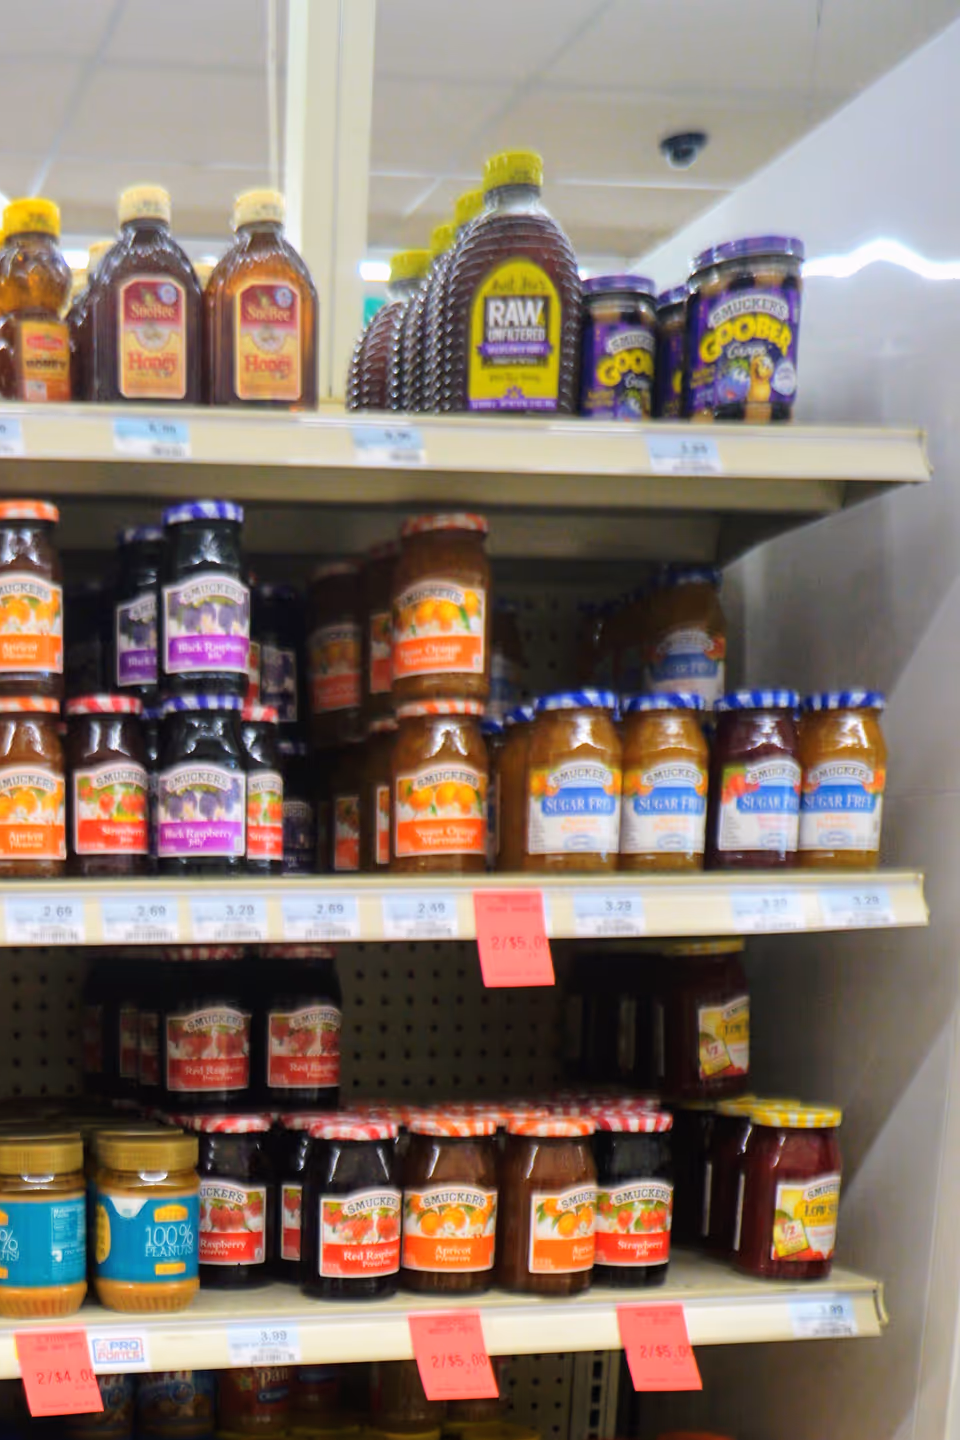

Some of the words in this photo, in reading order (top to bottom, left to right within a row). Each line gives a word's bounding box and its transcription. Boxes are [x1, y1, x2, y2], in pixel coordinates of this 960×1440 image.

[488, 302, 541, 328] RAW
[486, 328, 546, 342] UNFILTERED
[698, 313, 794, 364] GOOBER
[25, 359, 68, 371] HONEY
[128, 350, 178, 373] Honey
[244, 354, 294, 374] Honey
[1, 641, 38, 655] Apricot
[546, 799, 585, 811] SUGAR
[804, 797, 841, 809] SUGAR
[844, 797, 873, 809] FREE
[8, 831, 44, 843] Apricot
[144, 1224, 194, 1248] 100%
[435, 1244, 472, 1258] Apricot
[617, 1239, 664, 1252] Strawberry
[109, 1341, 139, 1352] PRO
[431, 1352, 488, 1369] 2/$5.00
